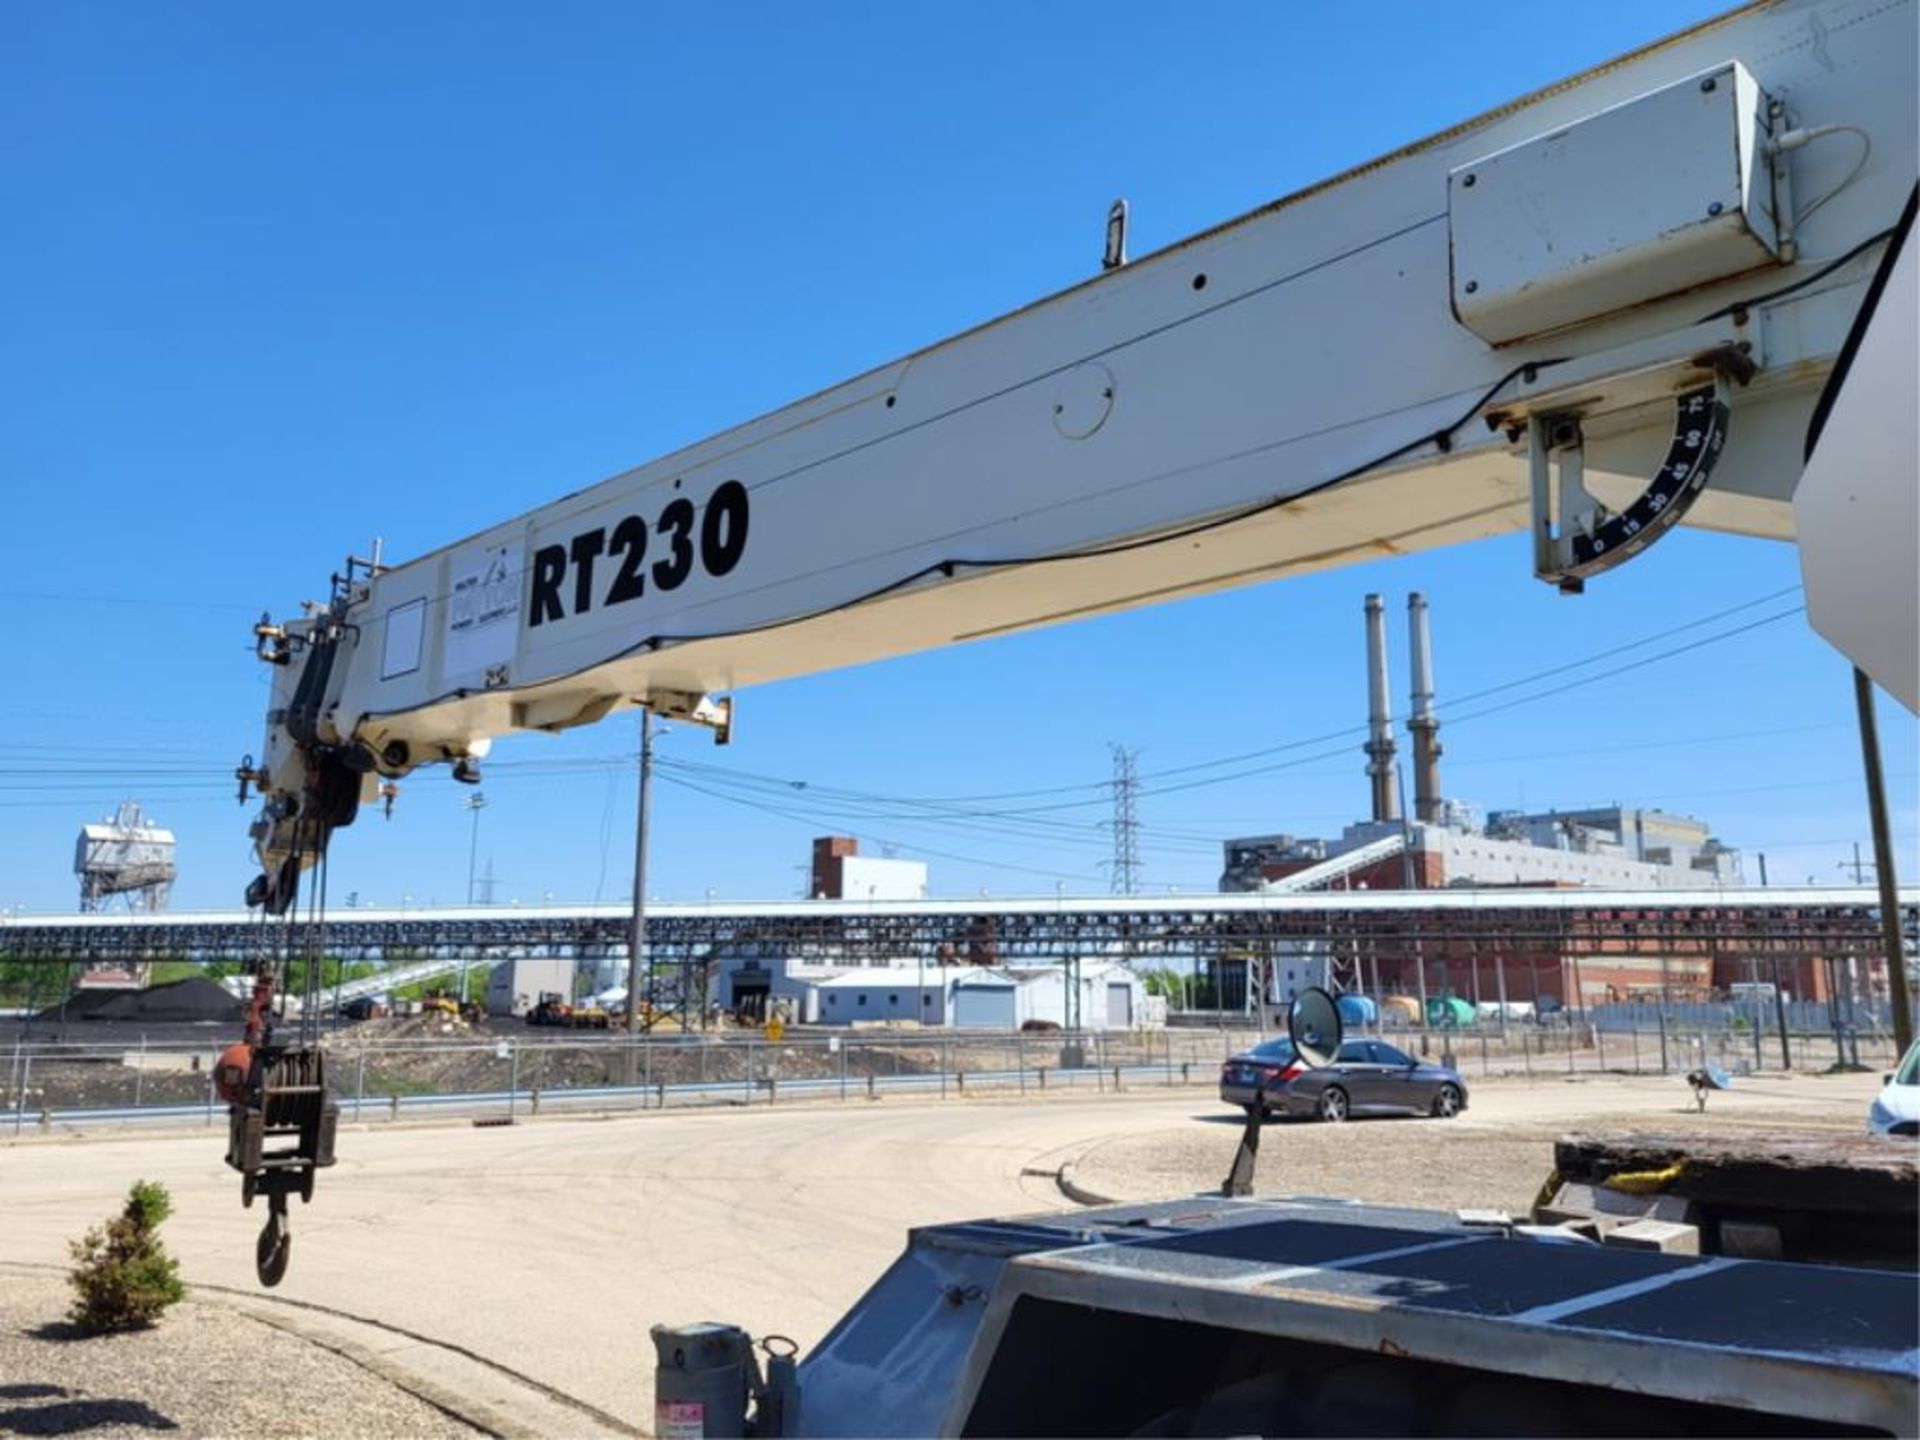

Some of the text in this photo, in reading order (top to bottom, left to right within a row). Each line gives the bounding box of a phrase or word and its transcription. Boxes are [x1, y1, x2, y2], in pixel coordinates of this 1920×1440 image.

[1672, 463, 1689, 480] 45
[1649, 493, 1667, 512] 30
[1622, 518, 1640, 535] 15
[529, 480, 749, 628] RT230
[1594, 540, 1604, 552] 0
